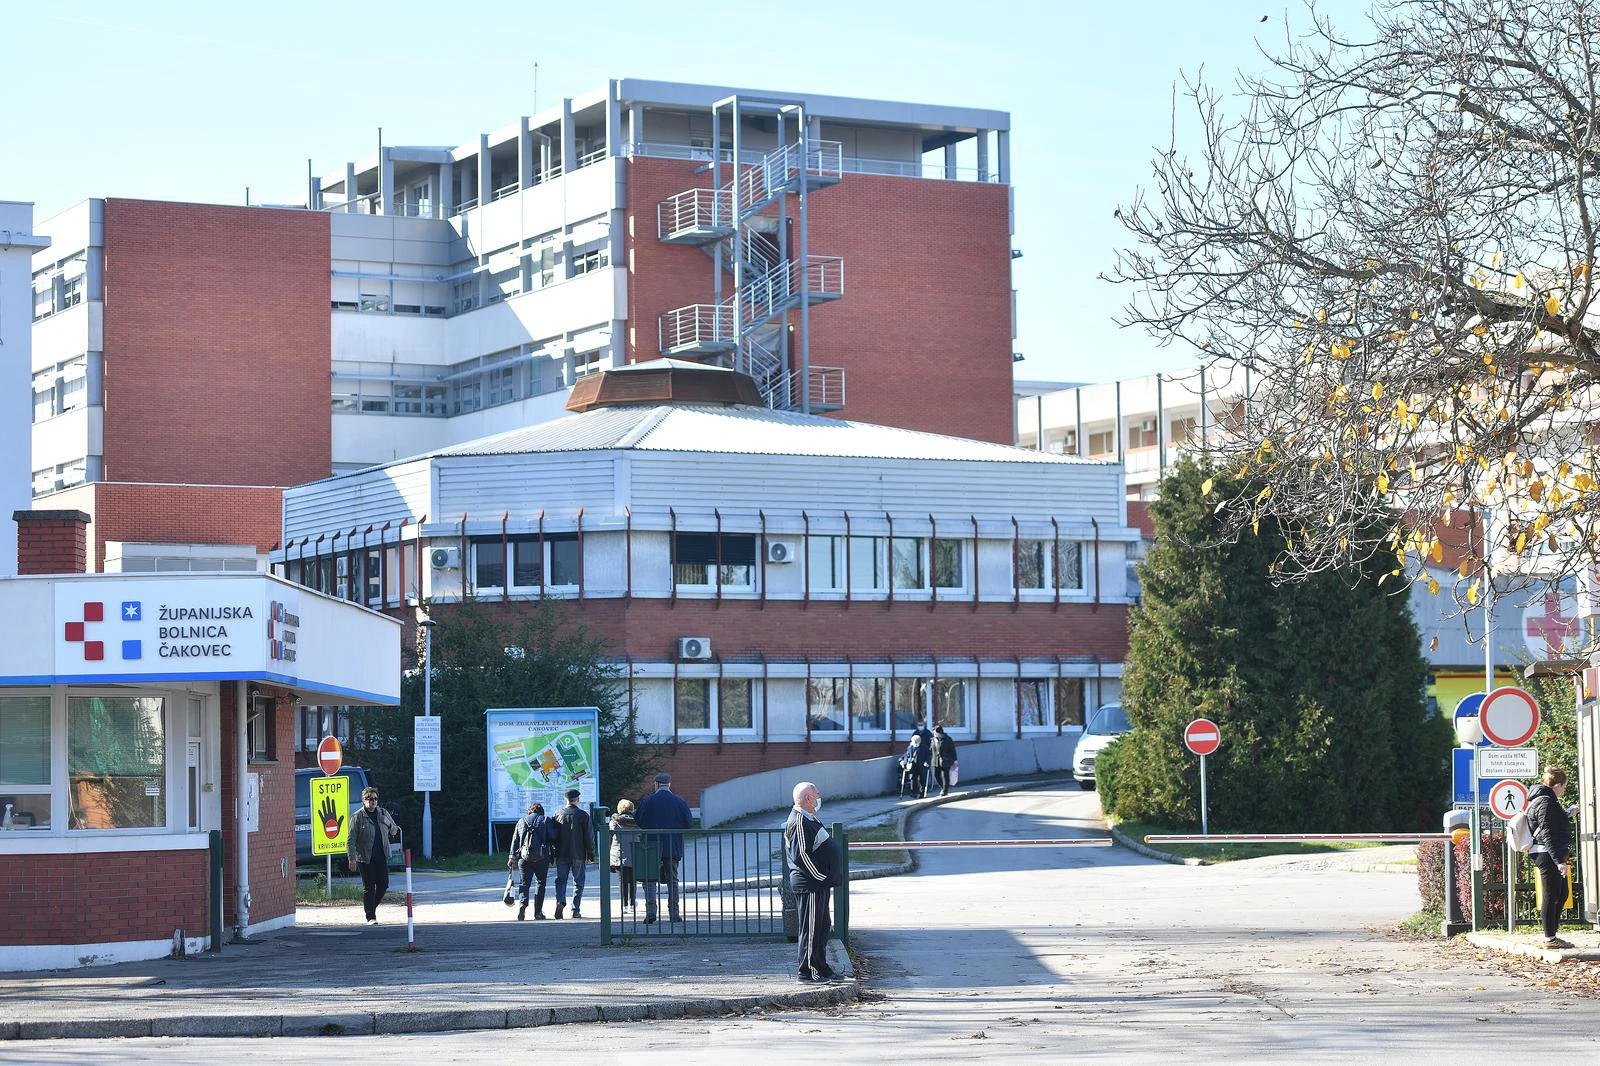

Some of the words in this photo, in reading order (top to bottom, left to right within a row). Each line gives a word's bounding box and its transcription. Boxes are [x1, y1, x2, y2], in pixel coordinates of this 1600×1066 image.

[159, 605, 253, 621] ŽUPANIJSKA
[159, 626, 228, 639] BOLNICA
[158, 642, 231, 658] ČAKOVEC
[319, 783, 342, 794] STOP
